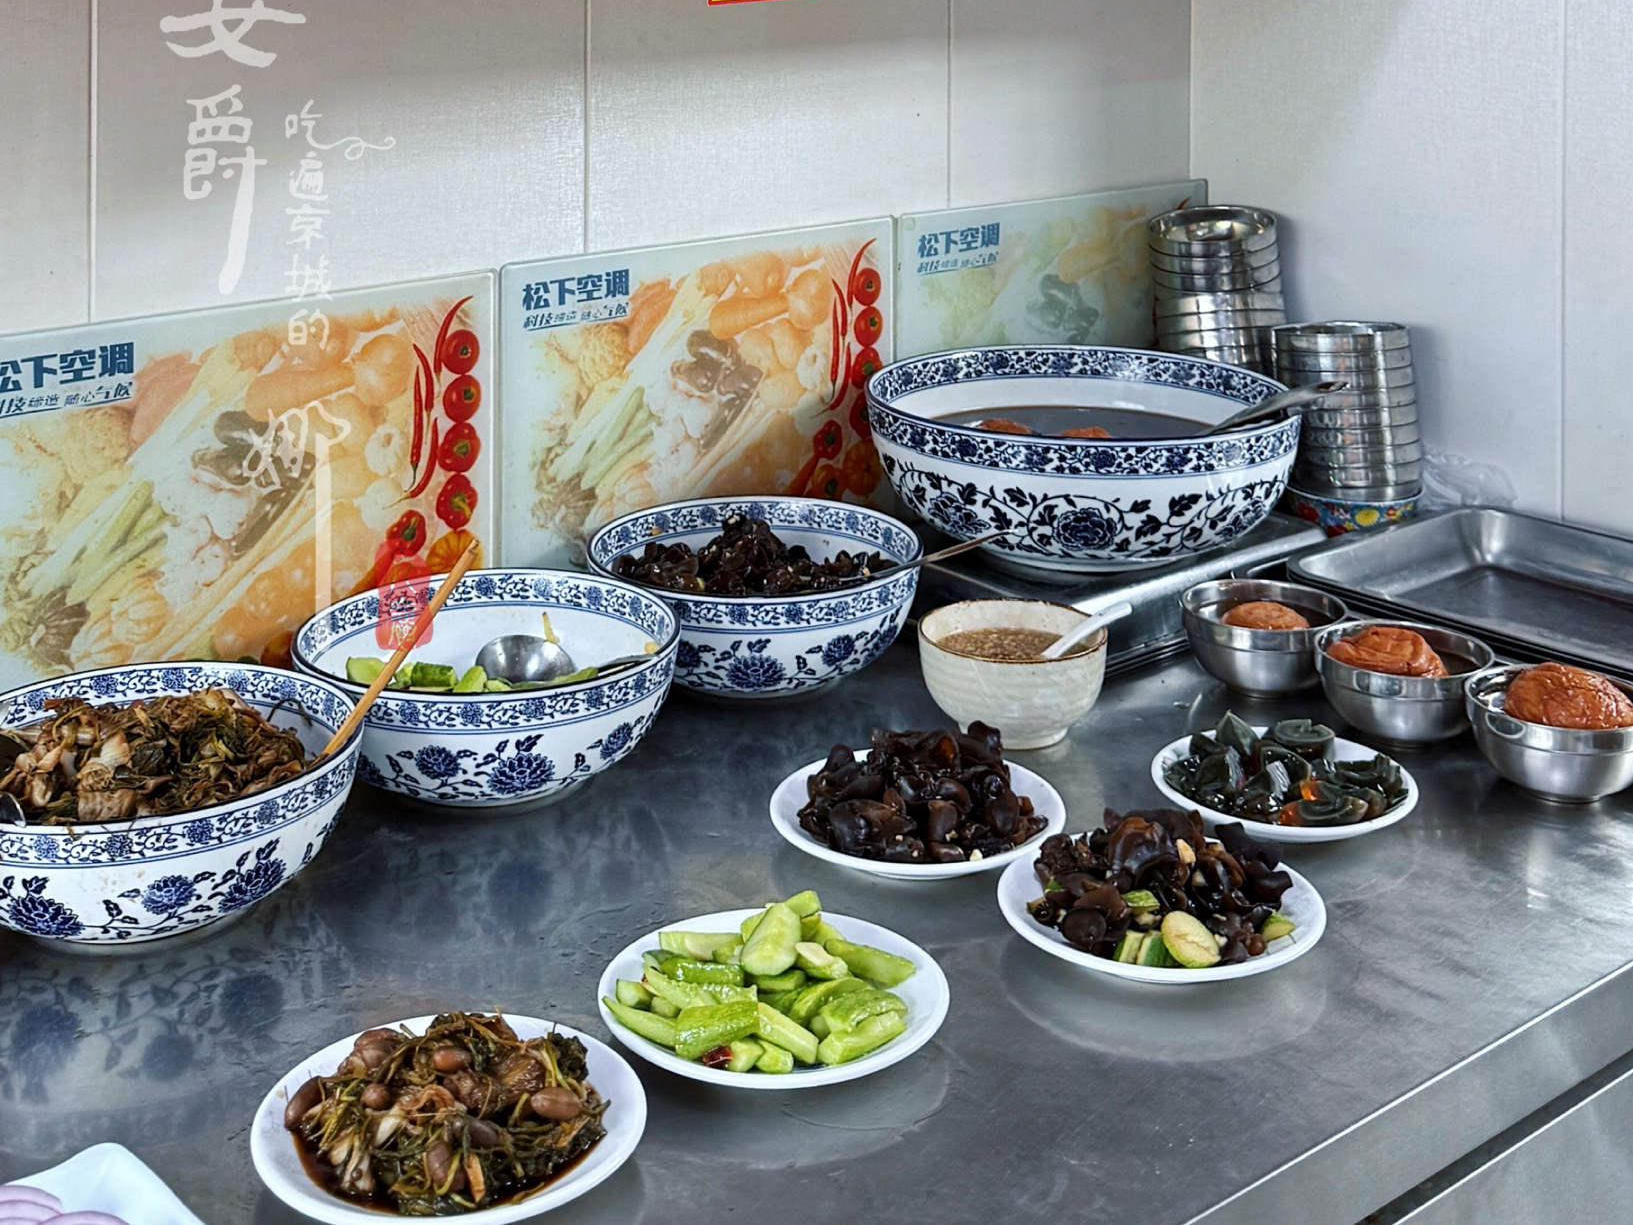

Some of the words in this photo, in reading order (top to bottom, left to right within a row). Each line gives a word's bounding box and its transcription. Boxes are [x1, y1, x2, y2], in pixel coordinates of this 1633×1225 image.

[917, 222, 1000, 259] 松下空调
[522, 268, 630, 311] 松下空调
